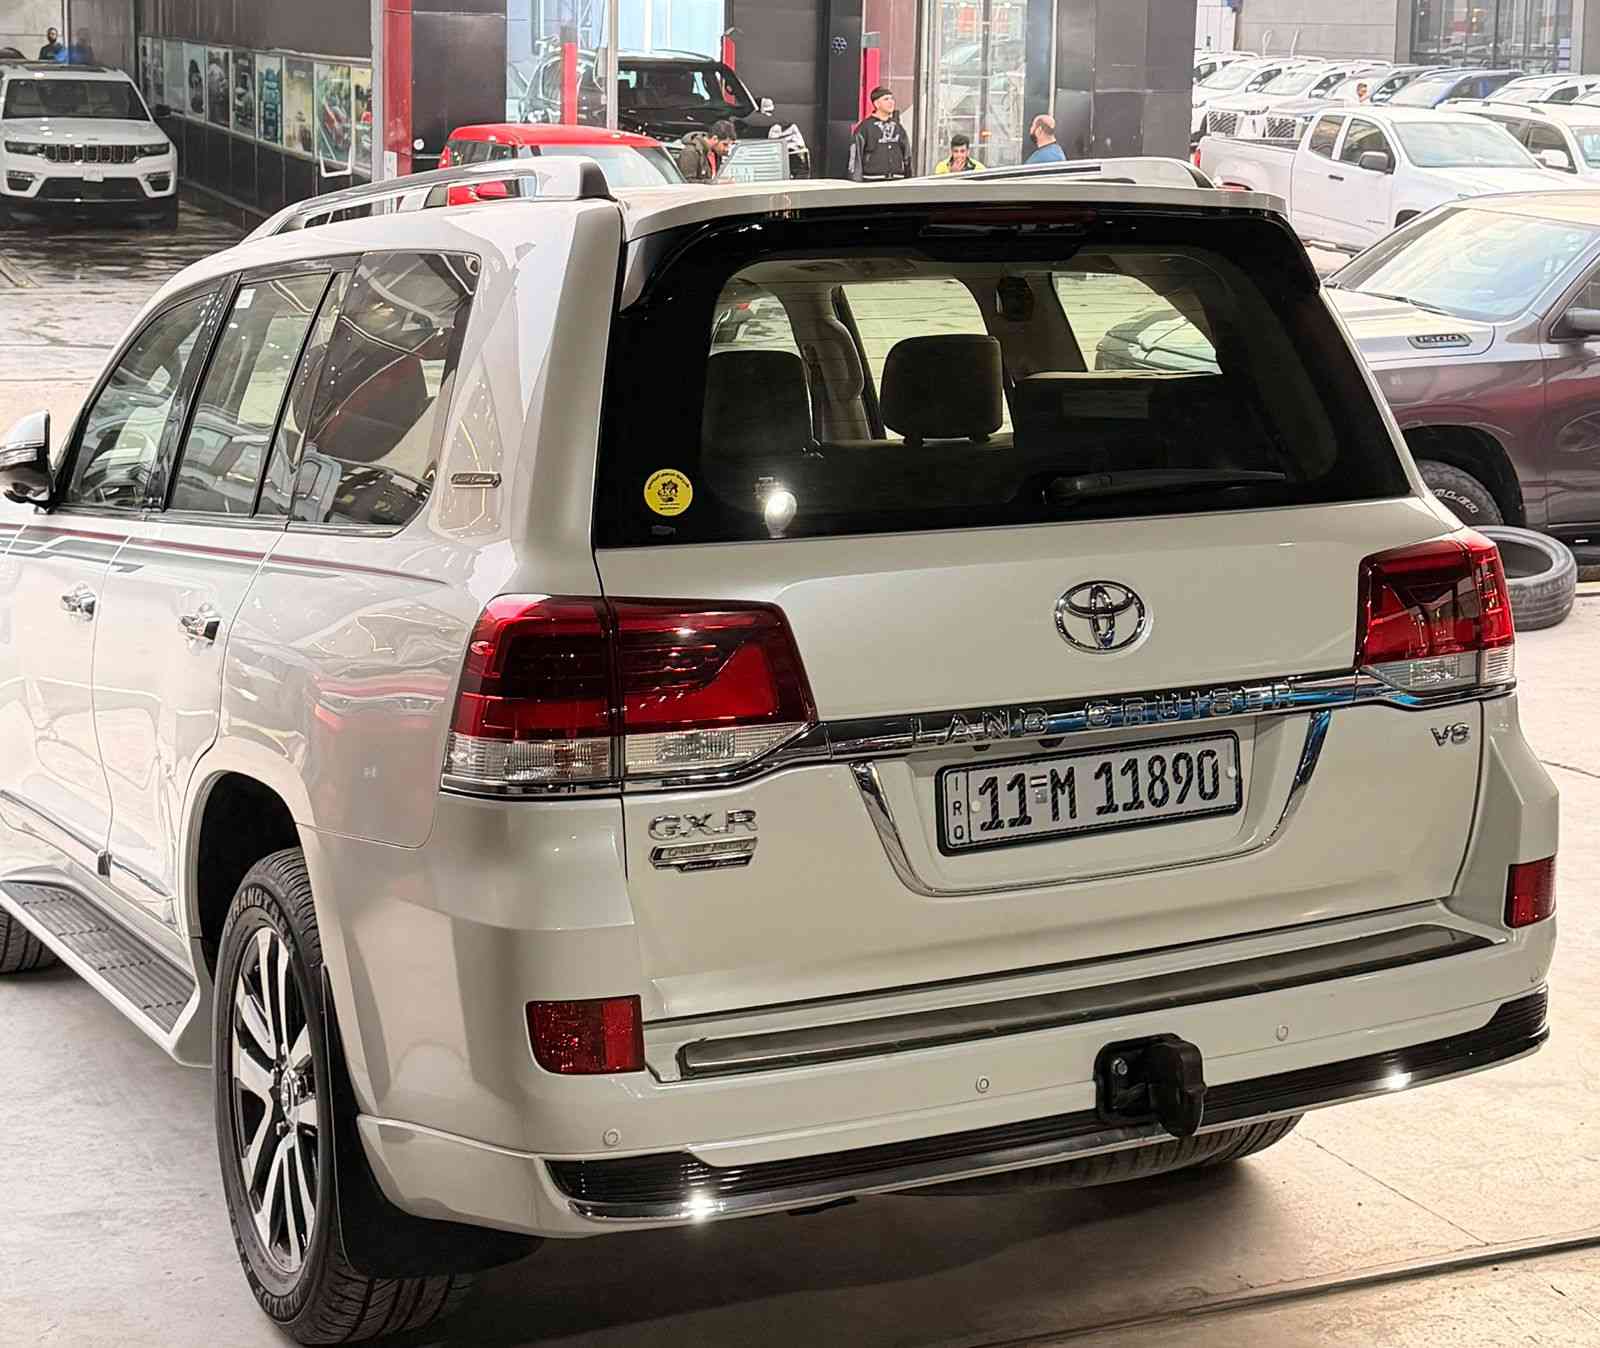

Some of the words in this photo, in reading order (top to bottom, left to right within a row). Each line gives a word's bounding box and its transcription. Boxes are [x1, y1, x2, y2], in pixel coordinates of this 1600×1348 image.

[910, 706, 1050, 744] LAND
[1085, 680, 1298, 727] CRUISER
[1431, 721, 1470, 746] V8
[1094, 749, 1220, 816] 11890
[648, 809, 758, 840] GXR
